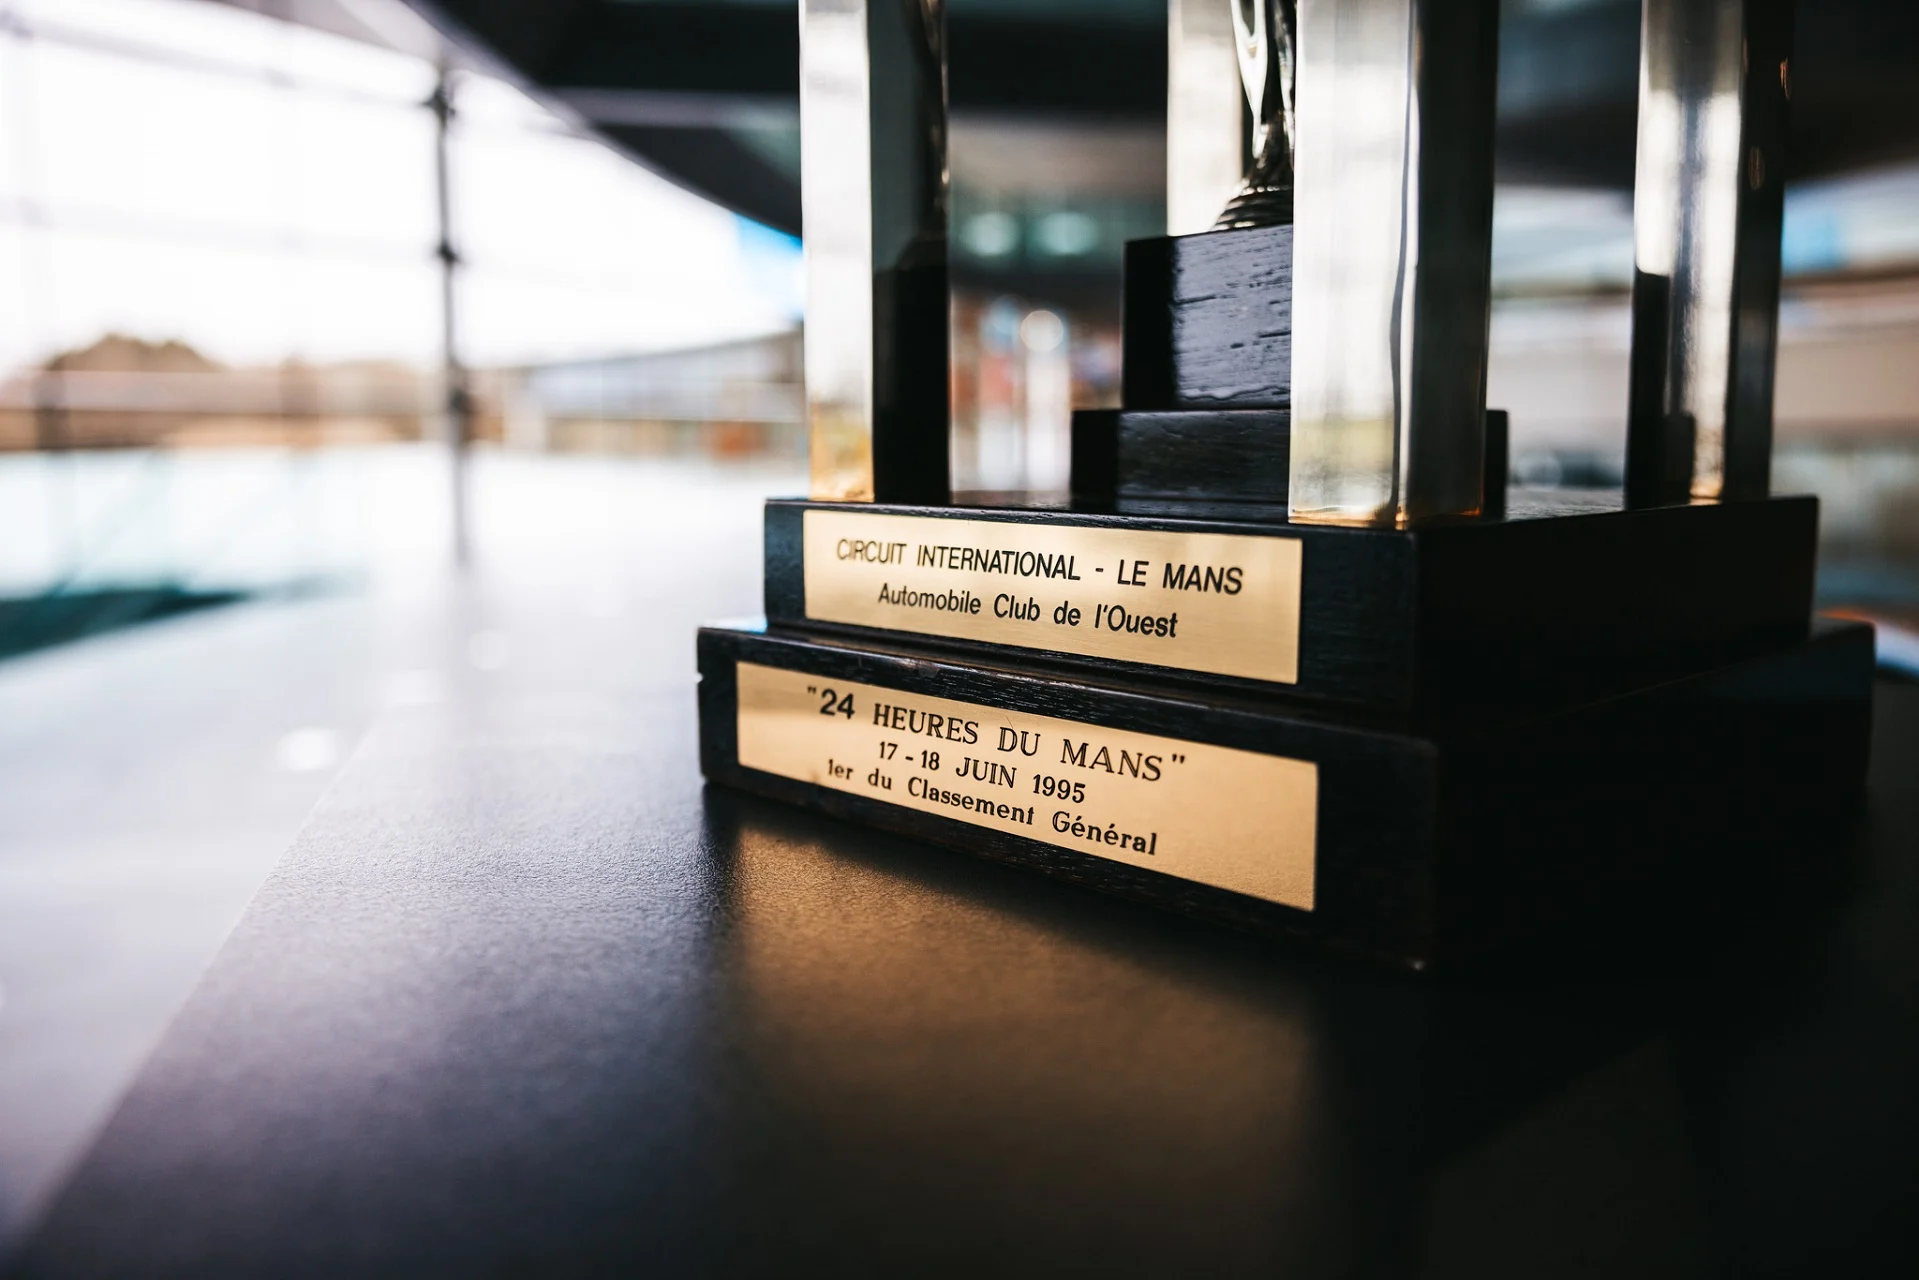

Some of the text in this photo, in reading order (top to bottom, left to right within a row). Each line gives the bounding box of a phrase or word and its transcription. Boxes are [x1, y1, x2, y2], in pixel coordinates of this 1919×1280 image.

[837, 539, 906, 565] CIRCUIT
[918, 545, 1080, 581] INTERNATIONAL
[1118, 559, 1149, 587] LE
[1163, 563, 1243, 594] MANS
[878, 583, 1177, 638] Automobile Club de l'Ouest
[873, 703, 978, 744] HEURES
[997, 727, 1040, 756] DU
[828, 759, 1157, 855] 1er du Classement Général
[956, 757, 1016, 789] JUIN
[1032, 774, 1086, 803] 1995
